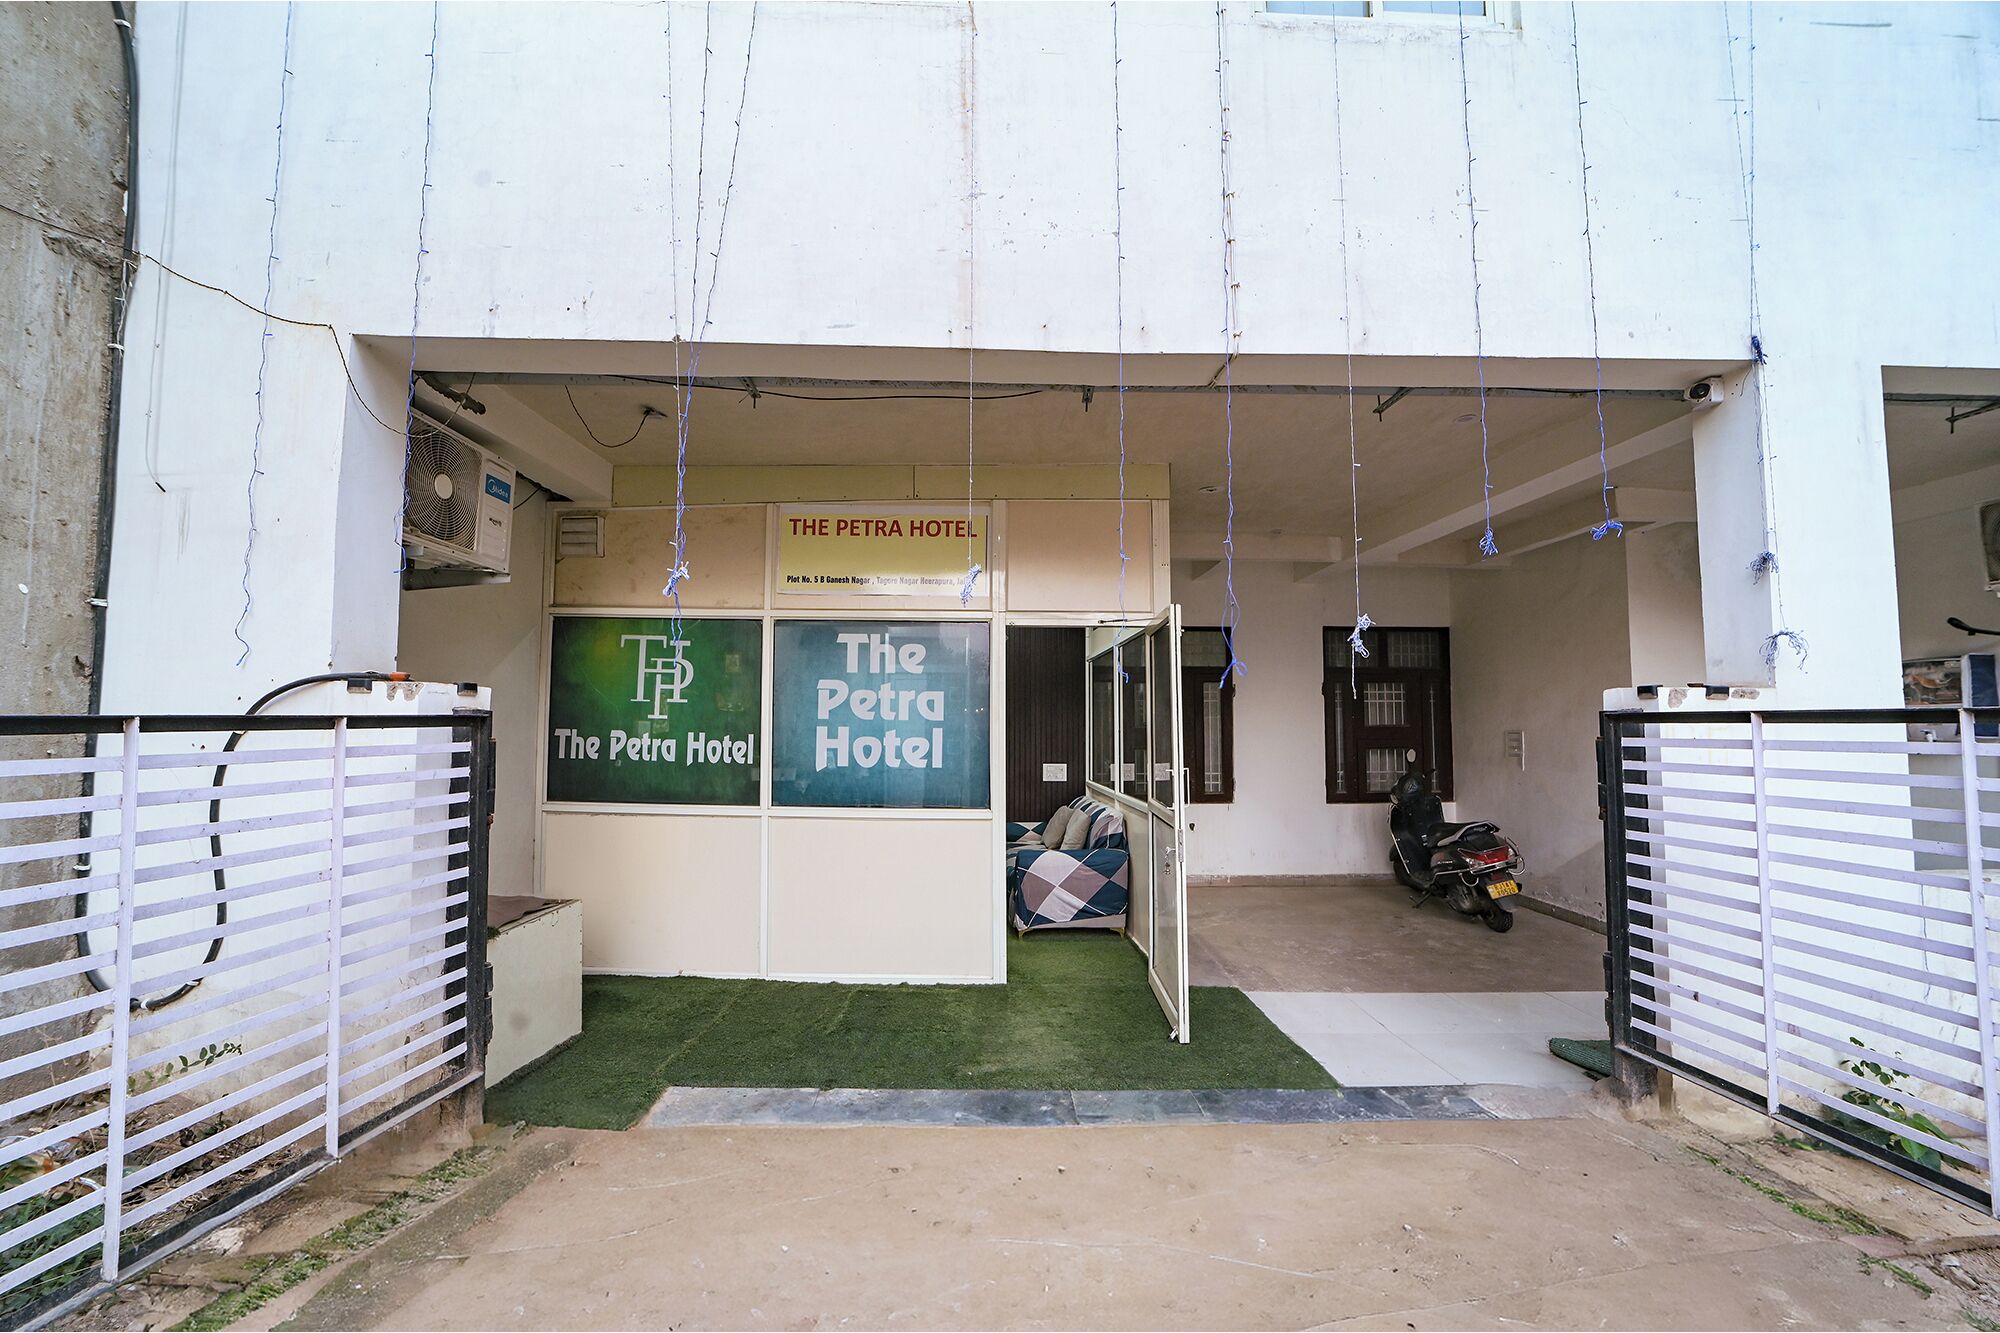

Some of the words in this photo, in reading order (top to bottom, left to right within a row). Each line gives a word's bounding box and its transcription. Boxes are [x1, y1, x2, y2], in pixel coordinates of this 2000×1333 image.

[789, 518, 829, 536] THE
[836, 518, 904, 537] PETRA
[910, 519, 977, 537] HOTEL
[786, 575, 800, 583] Plot
[801, 575, 812, 583] No.
[826, 576, 850, 584] Ganesh
[851, 576, 871, 586] Nagar
[899, 577, 919, 586] Nagar
[837, 633, 927, 674] The
[816, 679, 945, 721] Petra
[553, 728, 600, 760] The
[609, 730, 676, 762] Petra
[686, 732, 754, 767] Hotel
[816, 726, 943, 772] Hotel
